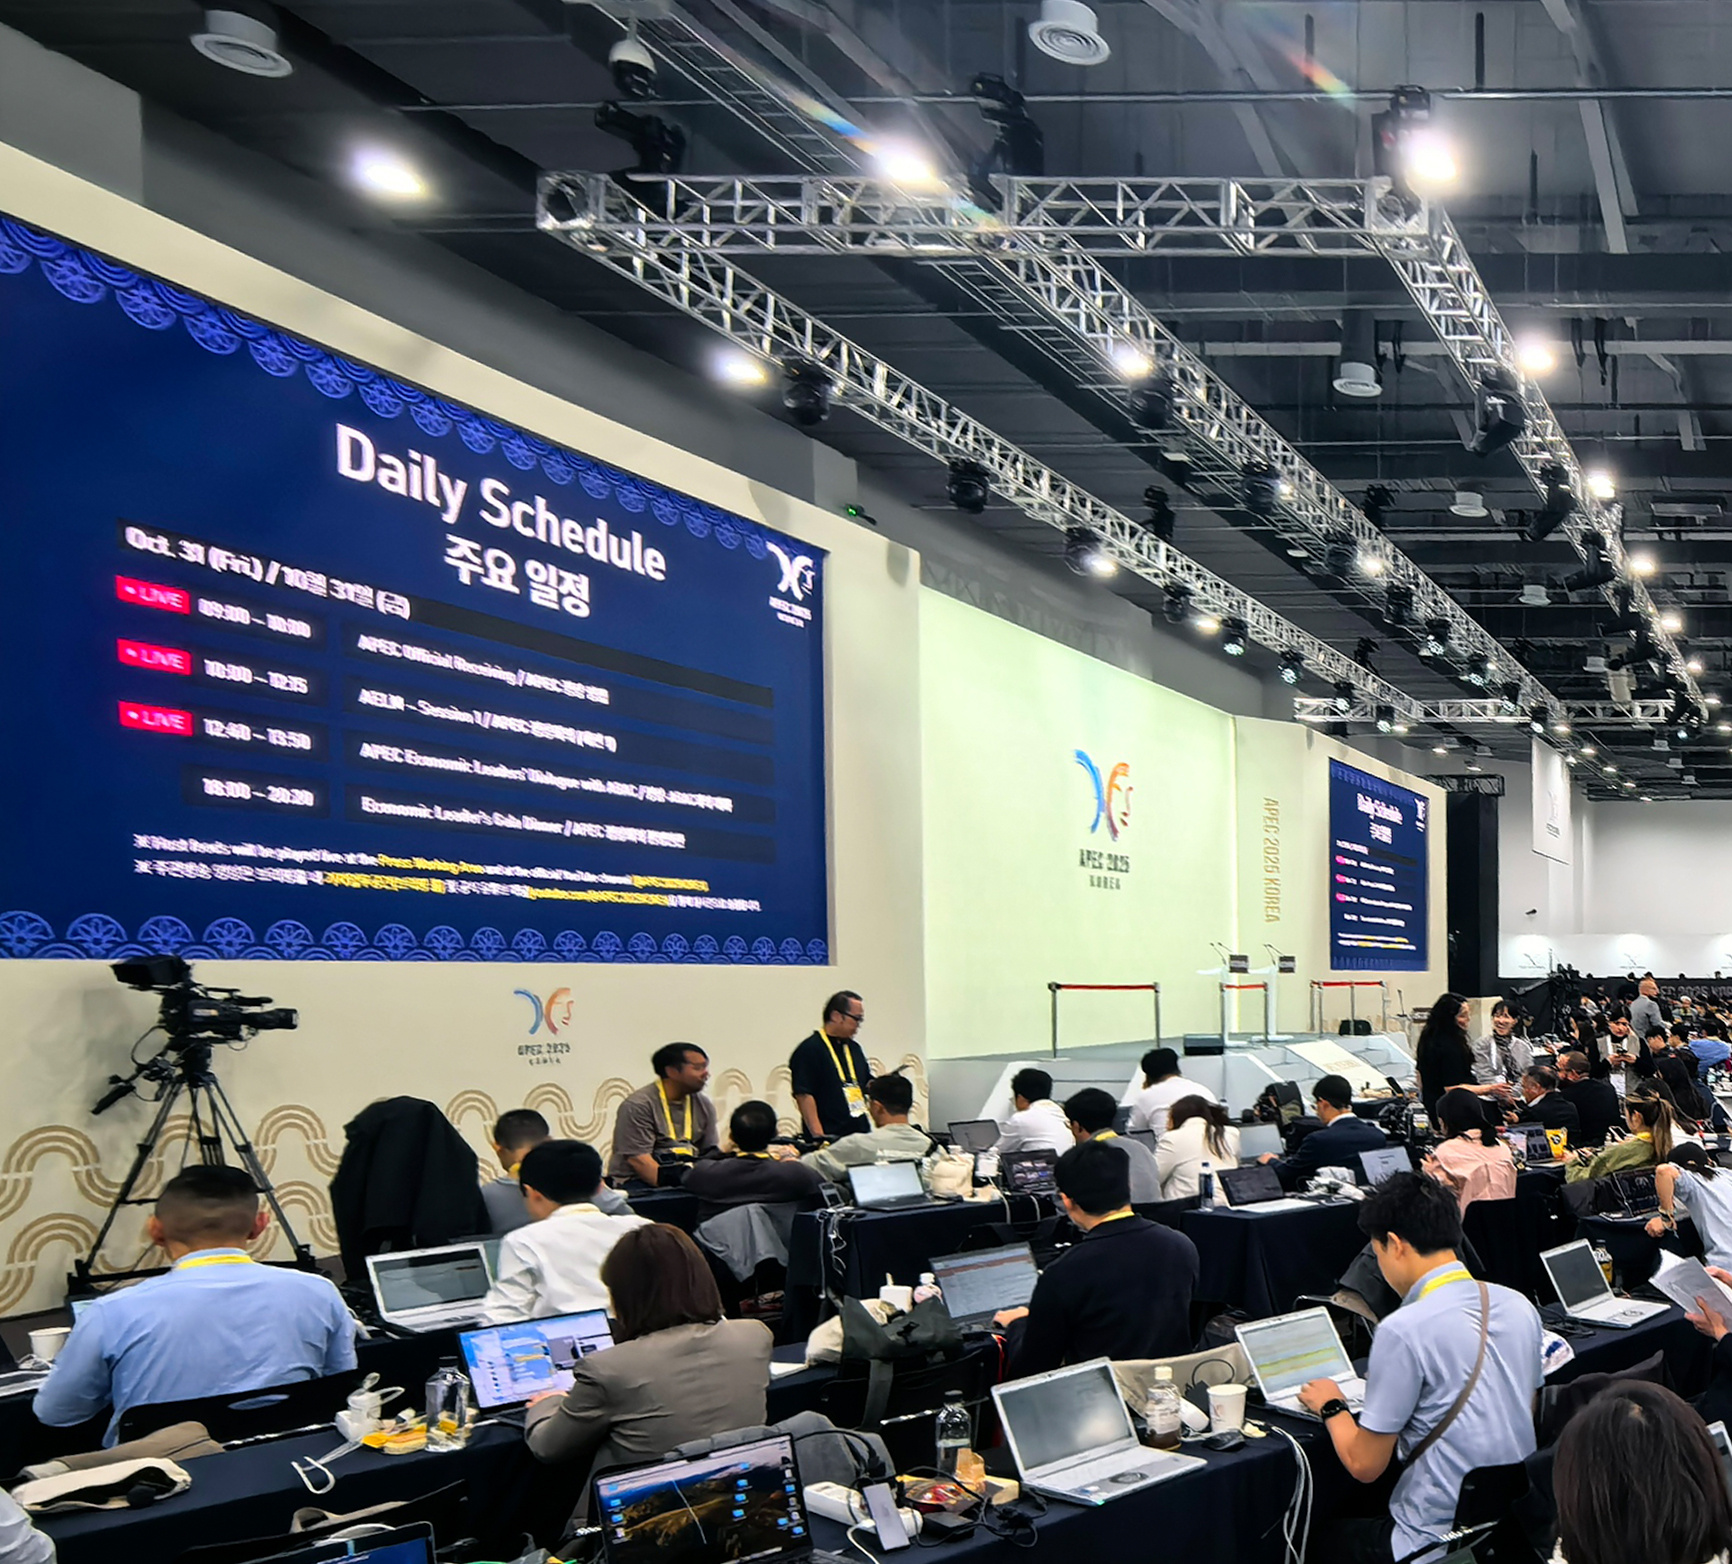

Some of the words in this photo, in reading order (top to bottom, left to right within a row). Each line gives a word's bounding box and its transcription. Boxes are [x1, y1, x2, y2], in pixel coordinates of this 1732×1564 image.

[336, 423, 467, 525] Daily
[479, 477, 665, 581] Schedule
[125, 526, 175, 558] Oct.
[177, 540, 206, 567] 31
[444, 533, 520, 595] 주요
[524, 558, 591, 618] 일정
[138, 586, 183, 607] LIVE
[358, 634, 402, 657] APEC
[140, 649, 184, 670] LIVE
[142, 710, 185, 730] LIVE
[359, 742, 404, 763] APEC
[1263, 797, 1280, 835] APEC
[1079, 849, 1103, 869] APEC
[1107, 853, 1129, 873] 2025
[1264, 878, 1282, 922] KOREA
